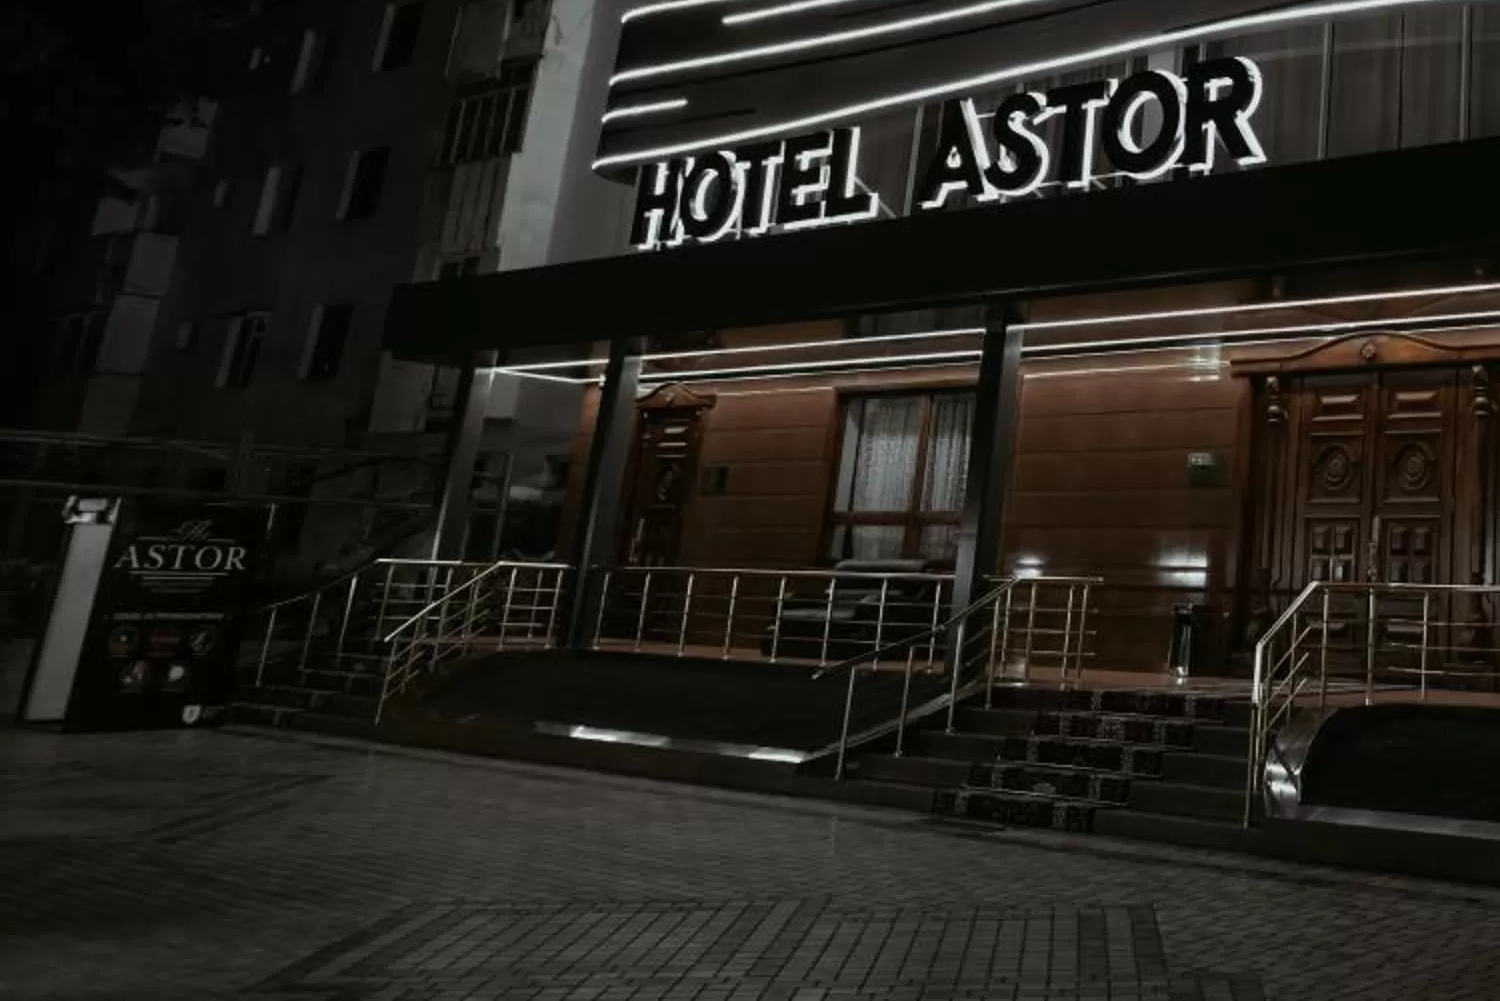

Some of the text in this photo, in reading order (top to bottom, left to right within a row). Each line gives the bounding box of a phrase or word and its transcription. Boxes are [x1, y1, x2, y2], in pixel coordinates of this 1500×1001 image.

[631, 55, 1268, 251] HOTEL ASTOR
[113, 543, 248, 571] ASTOR
